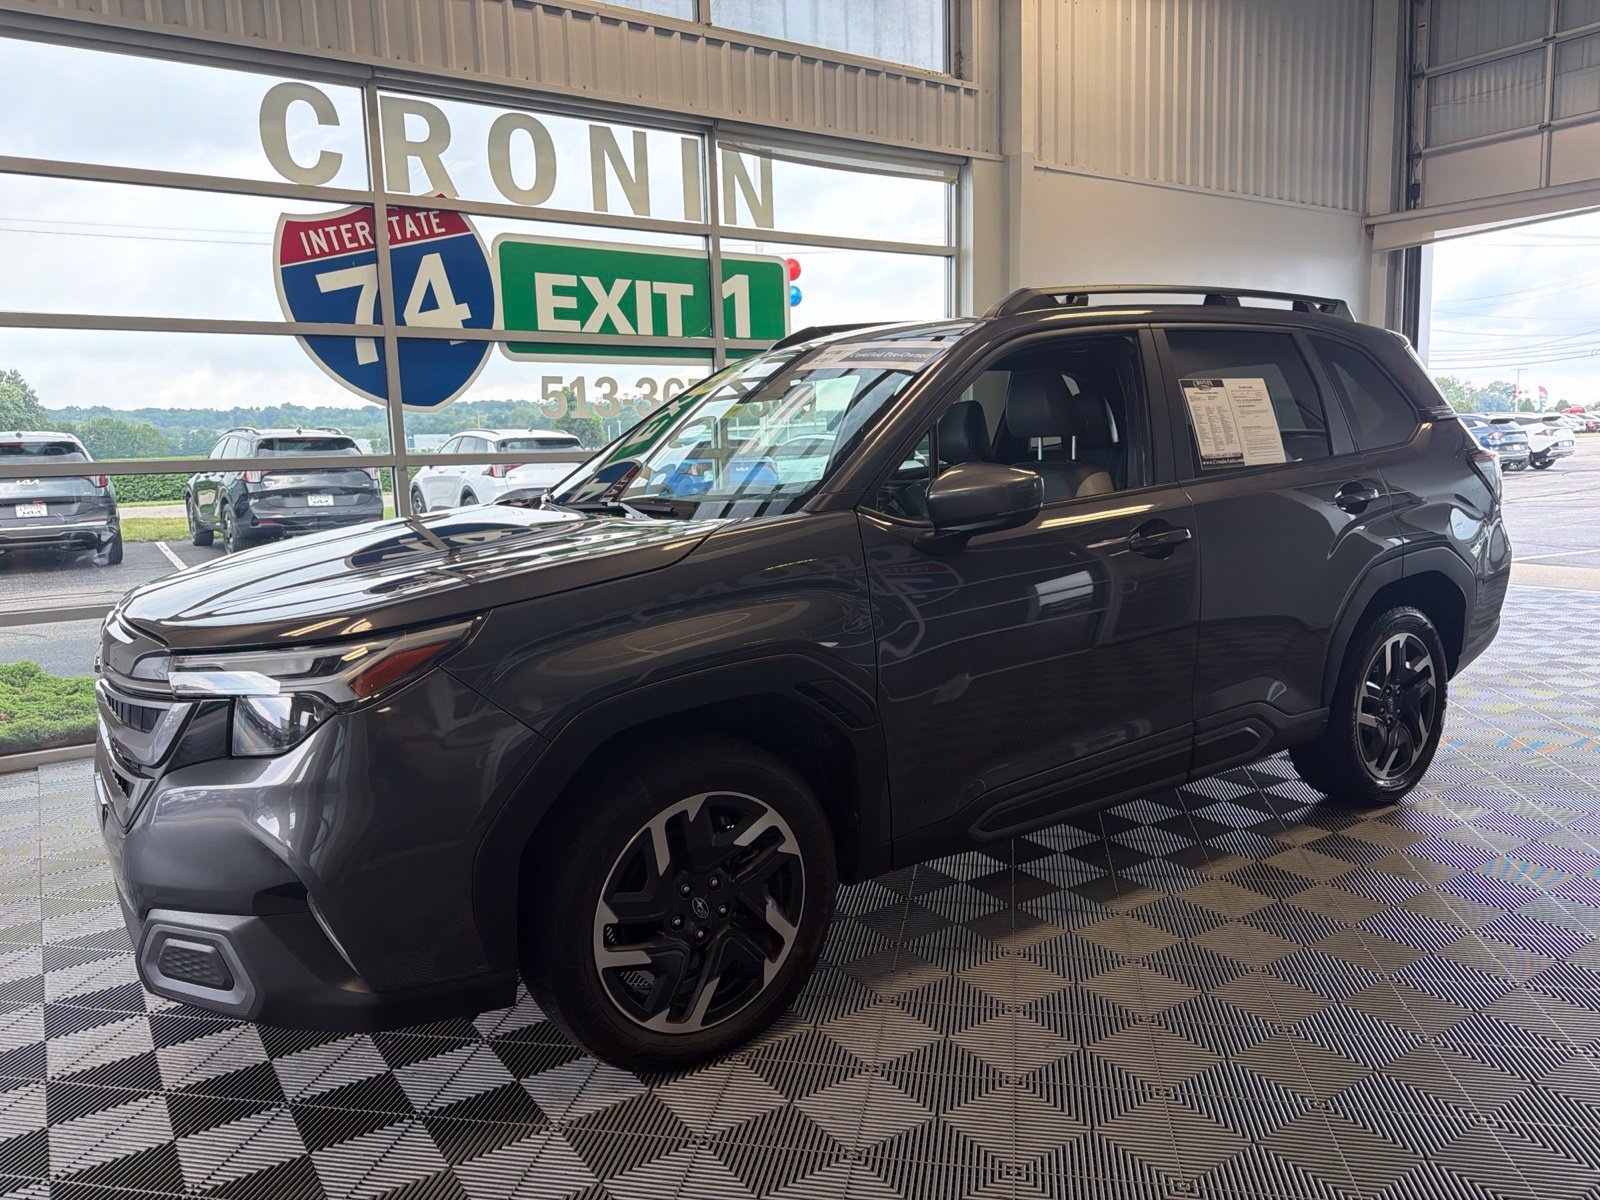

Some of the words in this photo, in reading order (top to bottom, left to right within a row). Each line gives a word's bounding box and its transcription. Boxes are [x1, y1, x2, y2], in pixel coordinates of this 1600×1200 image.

[258, 82, 775, 229] CRONIN
[299, 210, 446, 256] INTERTATE
[314, 252, 472, 366] 74
[534, 272, 695, 337] EXIT
[722, 274, 750, 339] 1
